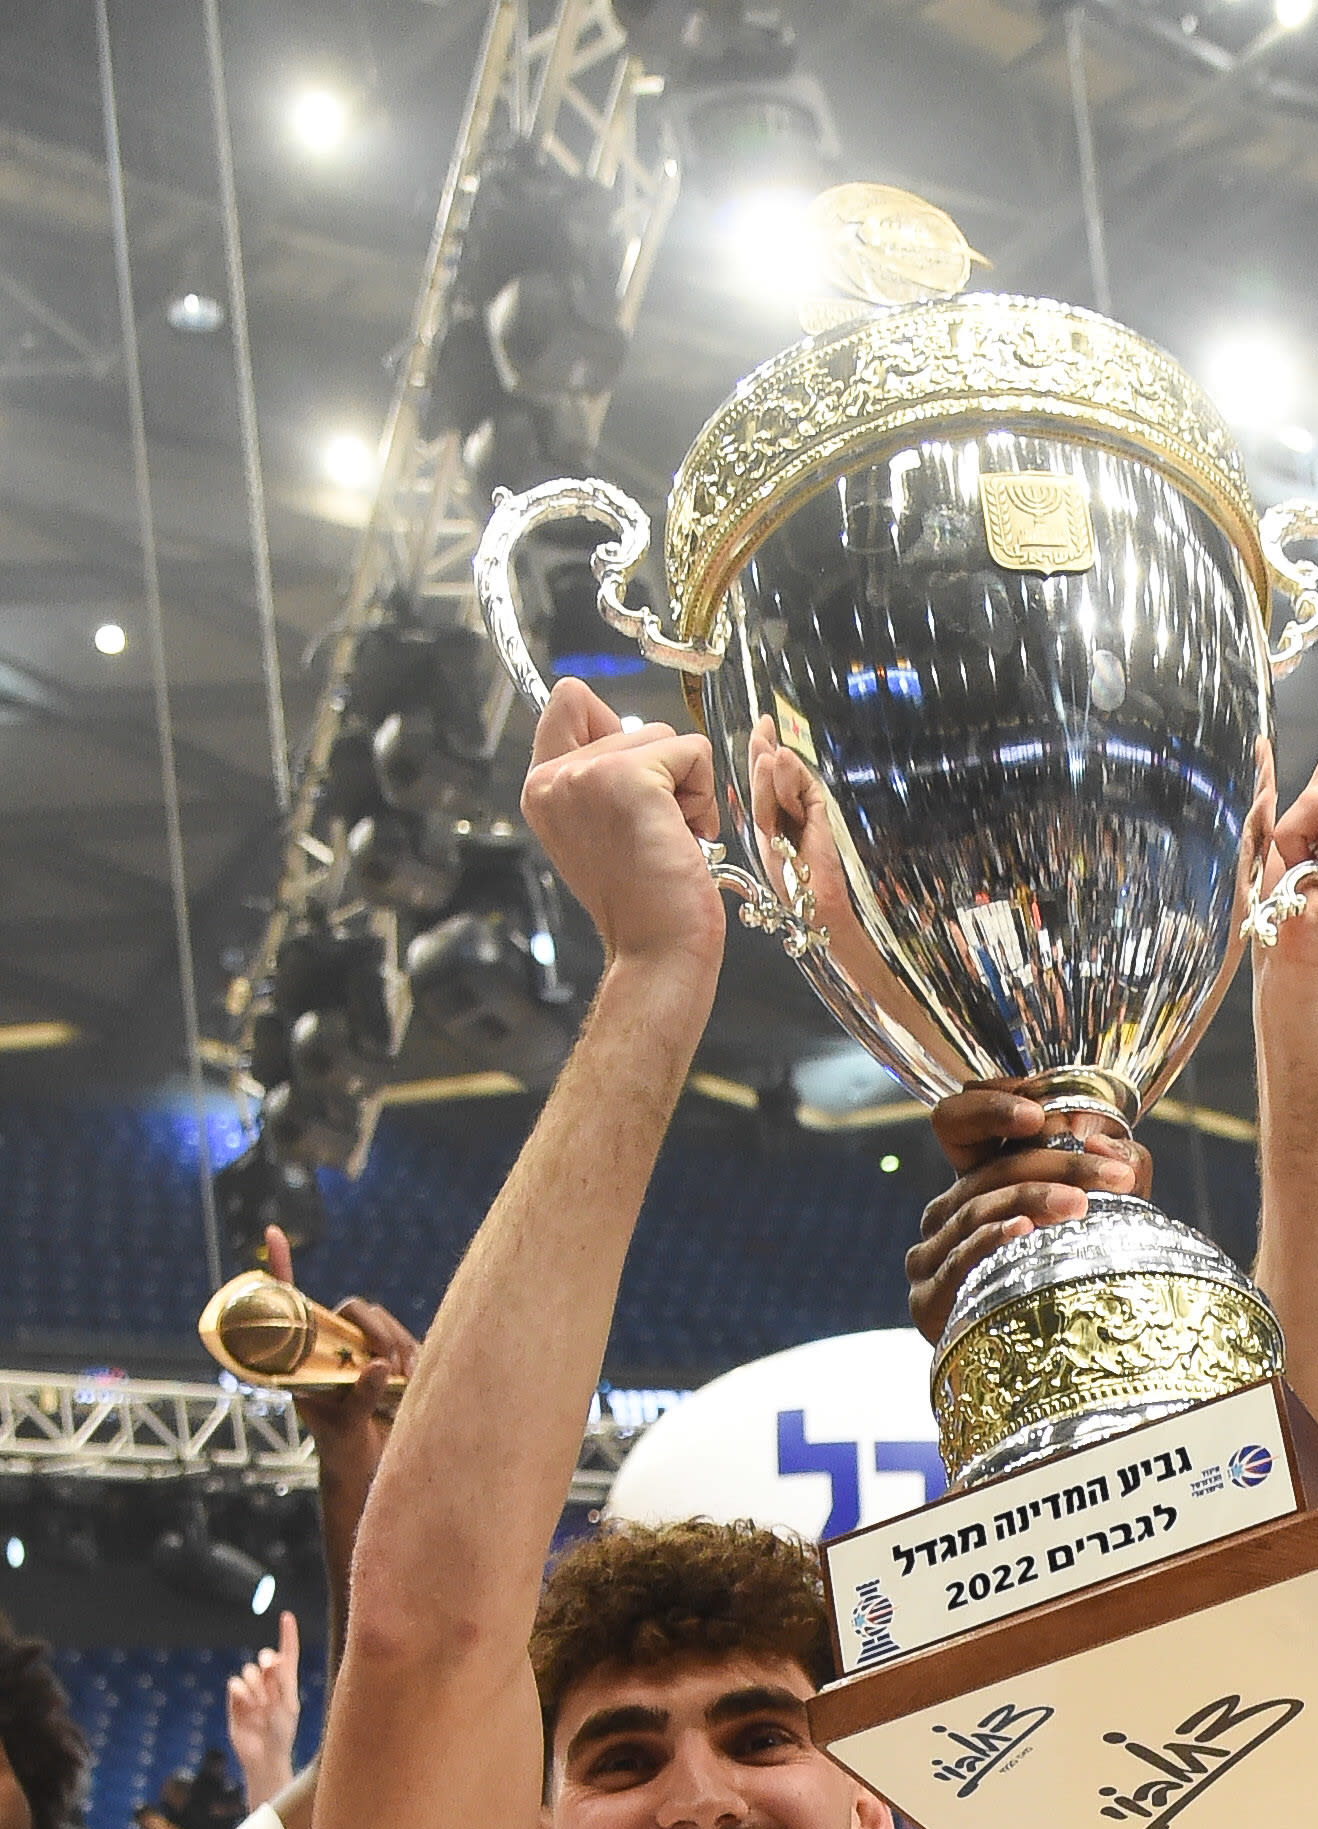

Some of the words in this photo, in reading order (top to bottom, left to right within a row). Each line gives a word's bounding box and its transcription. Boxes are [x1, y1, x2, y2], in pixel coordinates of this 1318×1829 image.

[1117, 1446, 1193, 1498] גביע
[994, 1475, 1110, 1543] המדינה
[892, 1523, 987, 1577] מגדל
[1047, 1503, 1178, 1573] לגברים
[945, 1555, 1038, 1610] 2022
